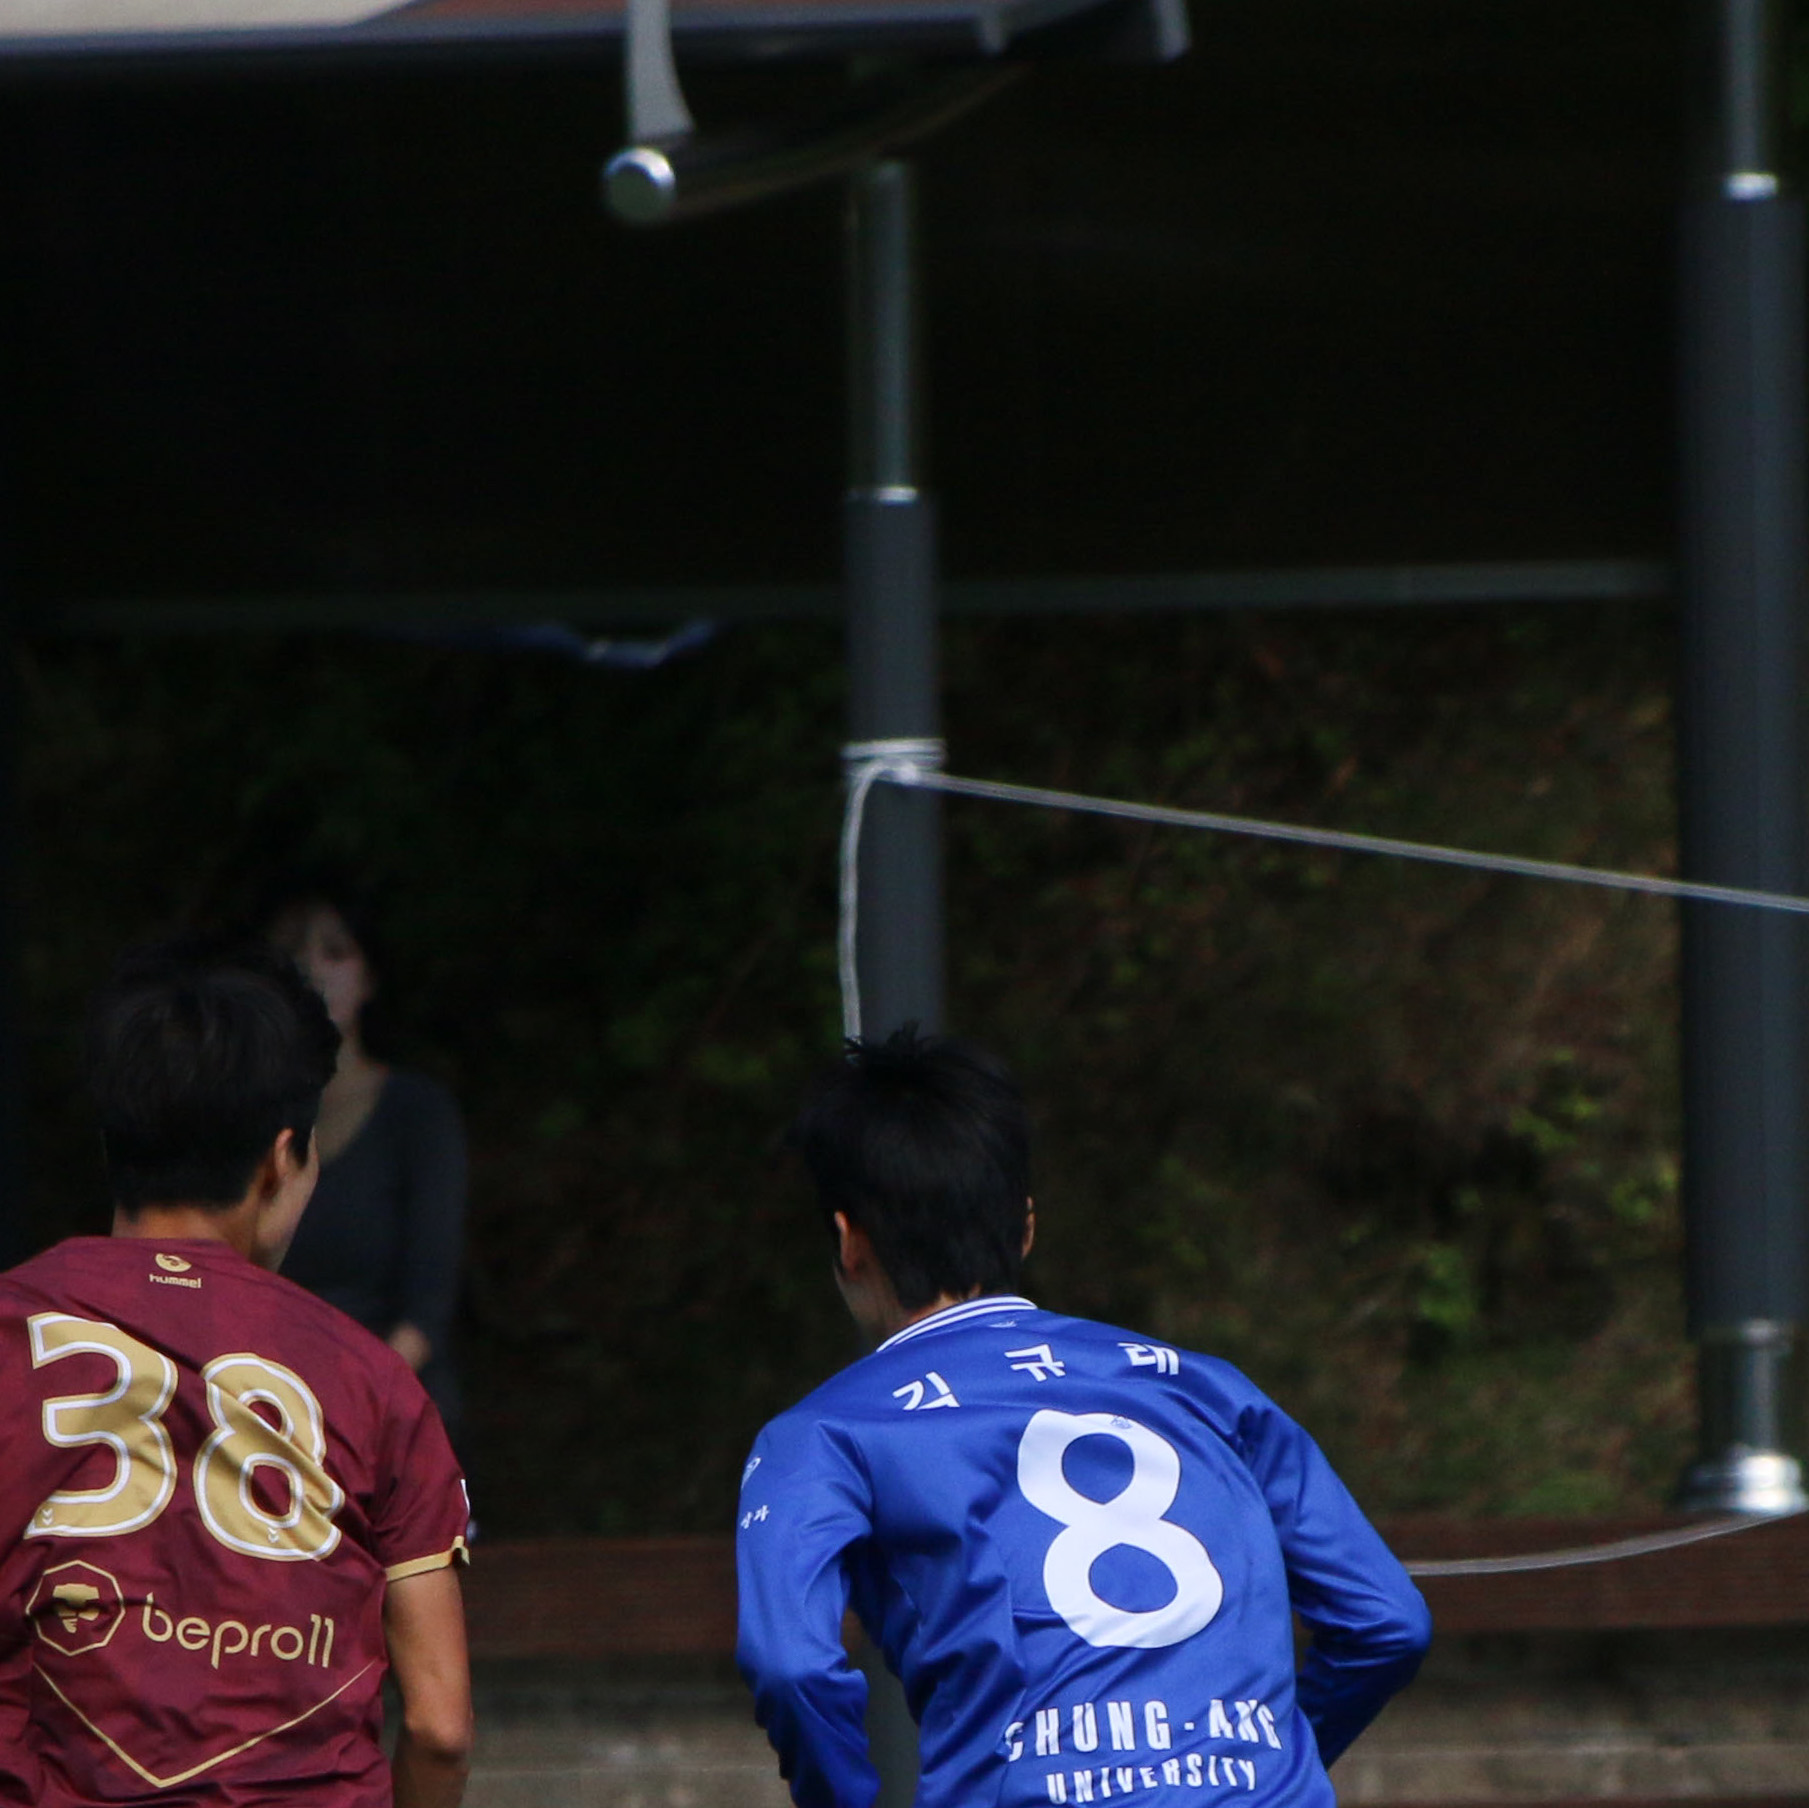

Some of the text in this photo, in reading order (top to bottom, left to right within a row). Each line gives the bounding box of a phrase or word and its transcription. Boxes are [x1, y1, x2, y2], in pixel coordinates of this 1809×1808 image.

[149, 1273, 202, 1289] hummel
[24, 1311, 345, 1562] 38
[1017, 1409, 1224, 1648] 8
[1046, 1753, 1256, 1804] UNIVERSITY
